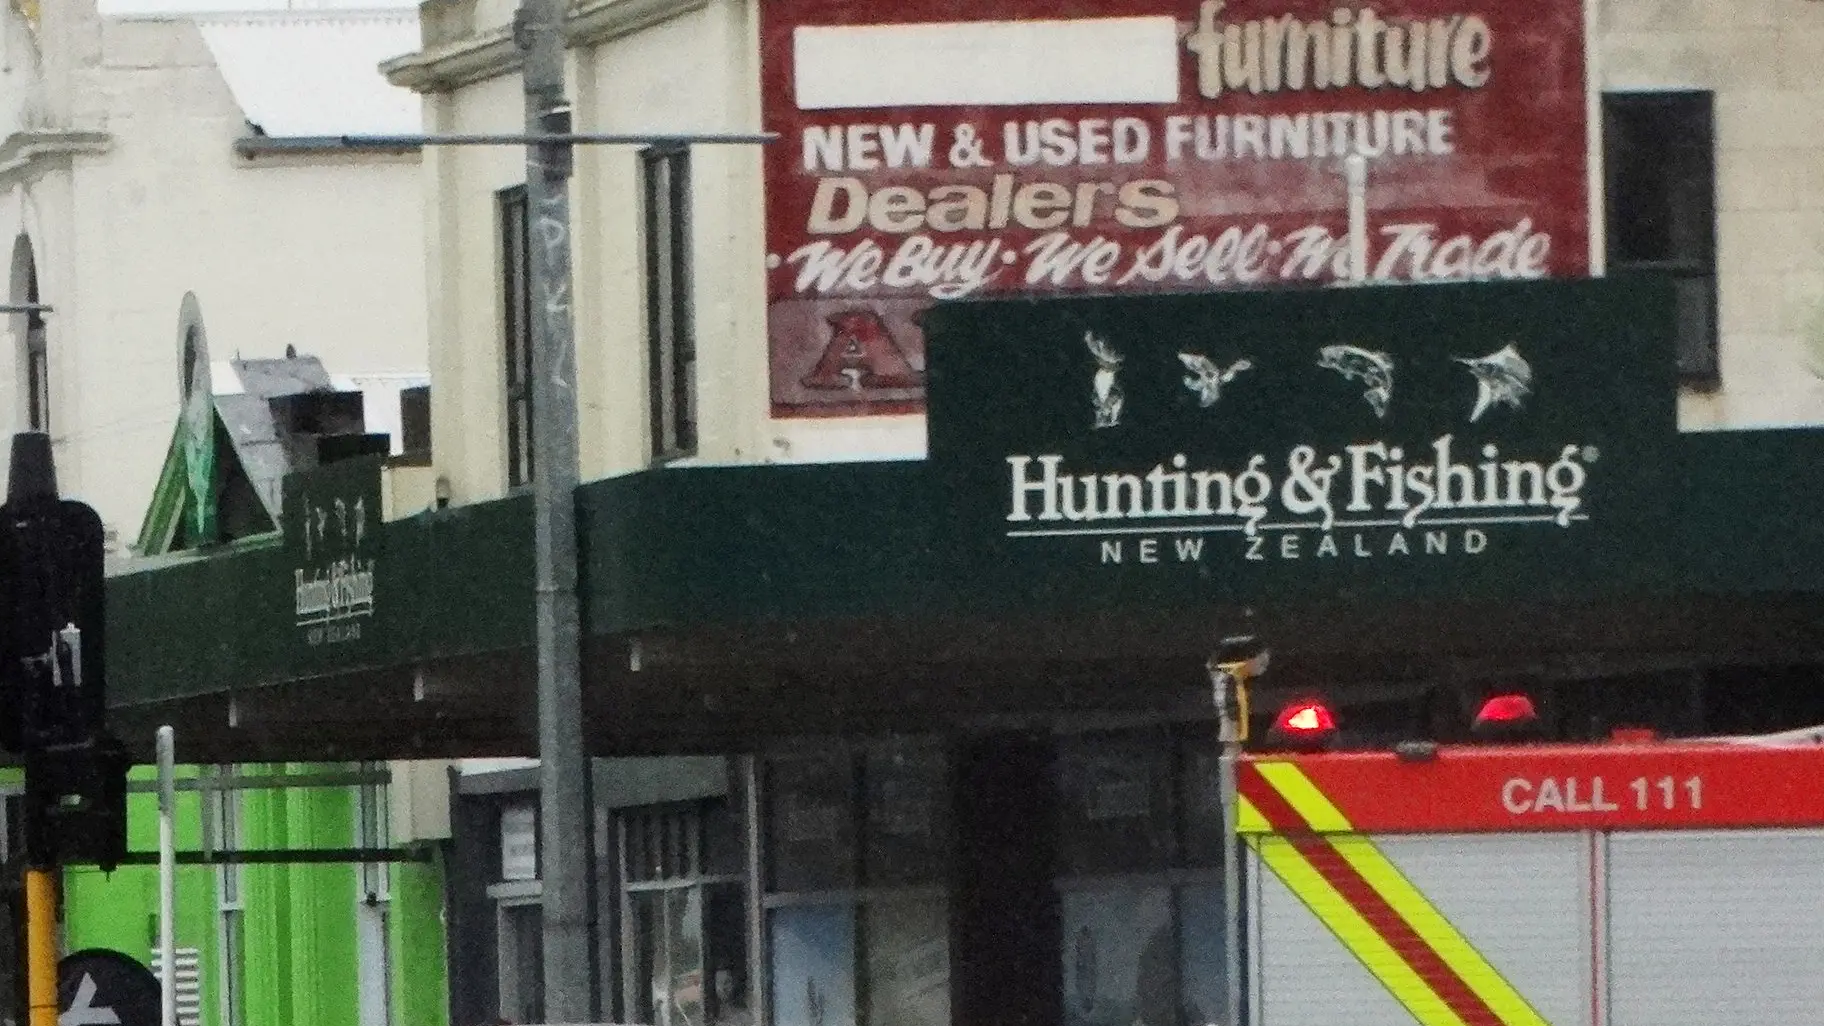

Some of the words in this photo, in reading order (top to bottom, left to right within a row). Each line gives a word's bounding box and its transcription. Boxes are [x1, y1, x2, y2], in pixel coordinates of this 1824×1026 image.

[1187, 0, 1492, 98] furniture
[803, 122, 935, 172] NEW
[948, 122, 994, 168] &
[1004, 117, 1151, 167] USED
[1165, 108, 1455, 161] FURNITURE
[807, 173, 1179, 234] Dealers
[882, 234, 1004, 299] Buy
[1023, 231, 1121, 285] We
[1376, 217, 1551, 281] Trade
[1006, 453, 1273, 535] Hunting
[1281, 444, 1341, 529] &
[1100, 539, 1204, 563] NEW
[1244, 530, 1489, 561] ZEALAND
[1501, 776, 1619, 815] CALL
[1629, 775, 1702, 811] 111
